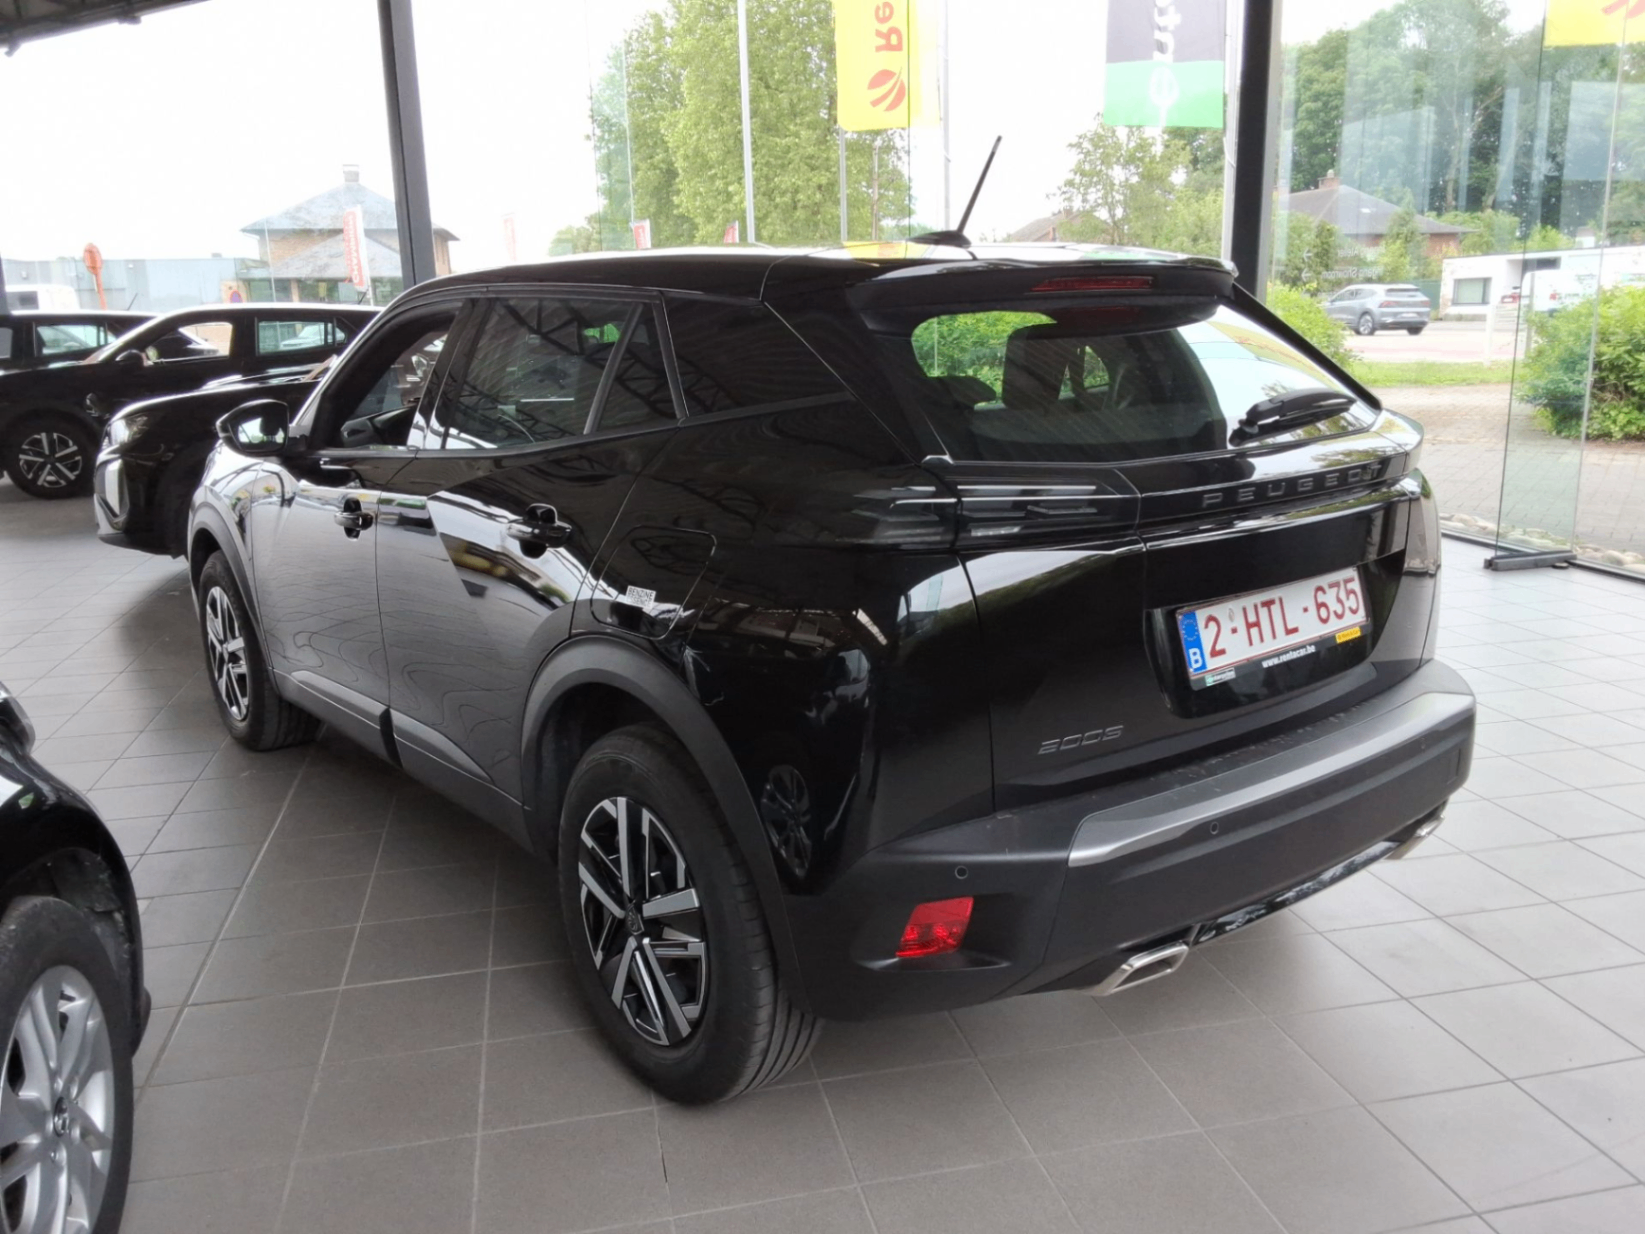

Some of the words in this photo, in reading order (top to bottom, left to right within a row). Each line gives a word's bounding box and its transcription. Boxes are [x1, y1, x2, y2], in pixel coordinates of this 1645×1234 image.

[1202, 463, 1382, 508] PEUGEOT
[628, 587, 655, 600] BENZINE
[1204, 576, 1360, 659] 2-HTL-635
[1188, 647, 1203, 669] B
[1261, 644, 1316, 669] www.rentacar.be
